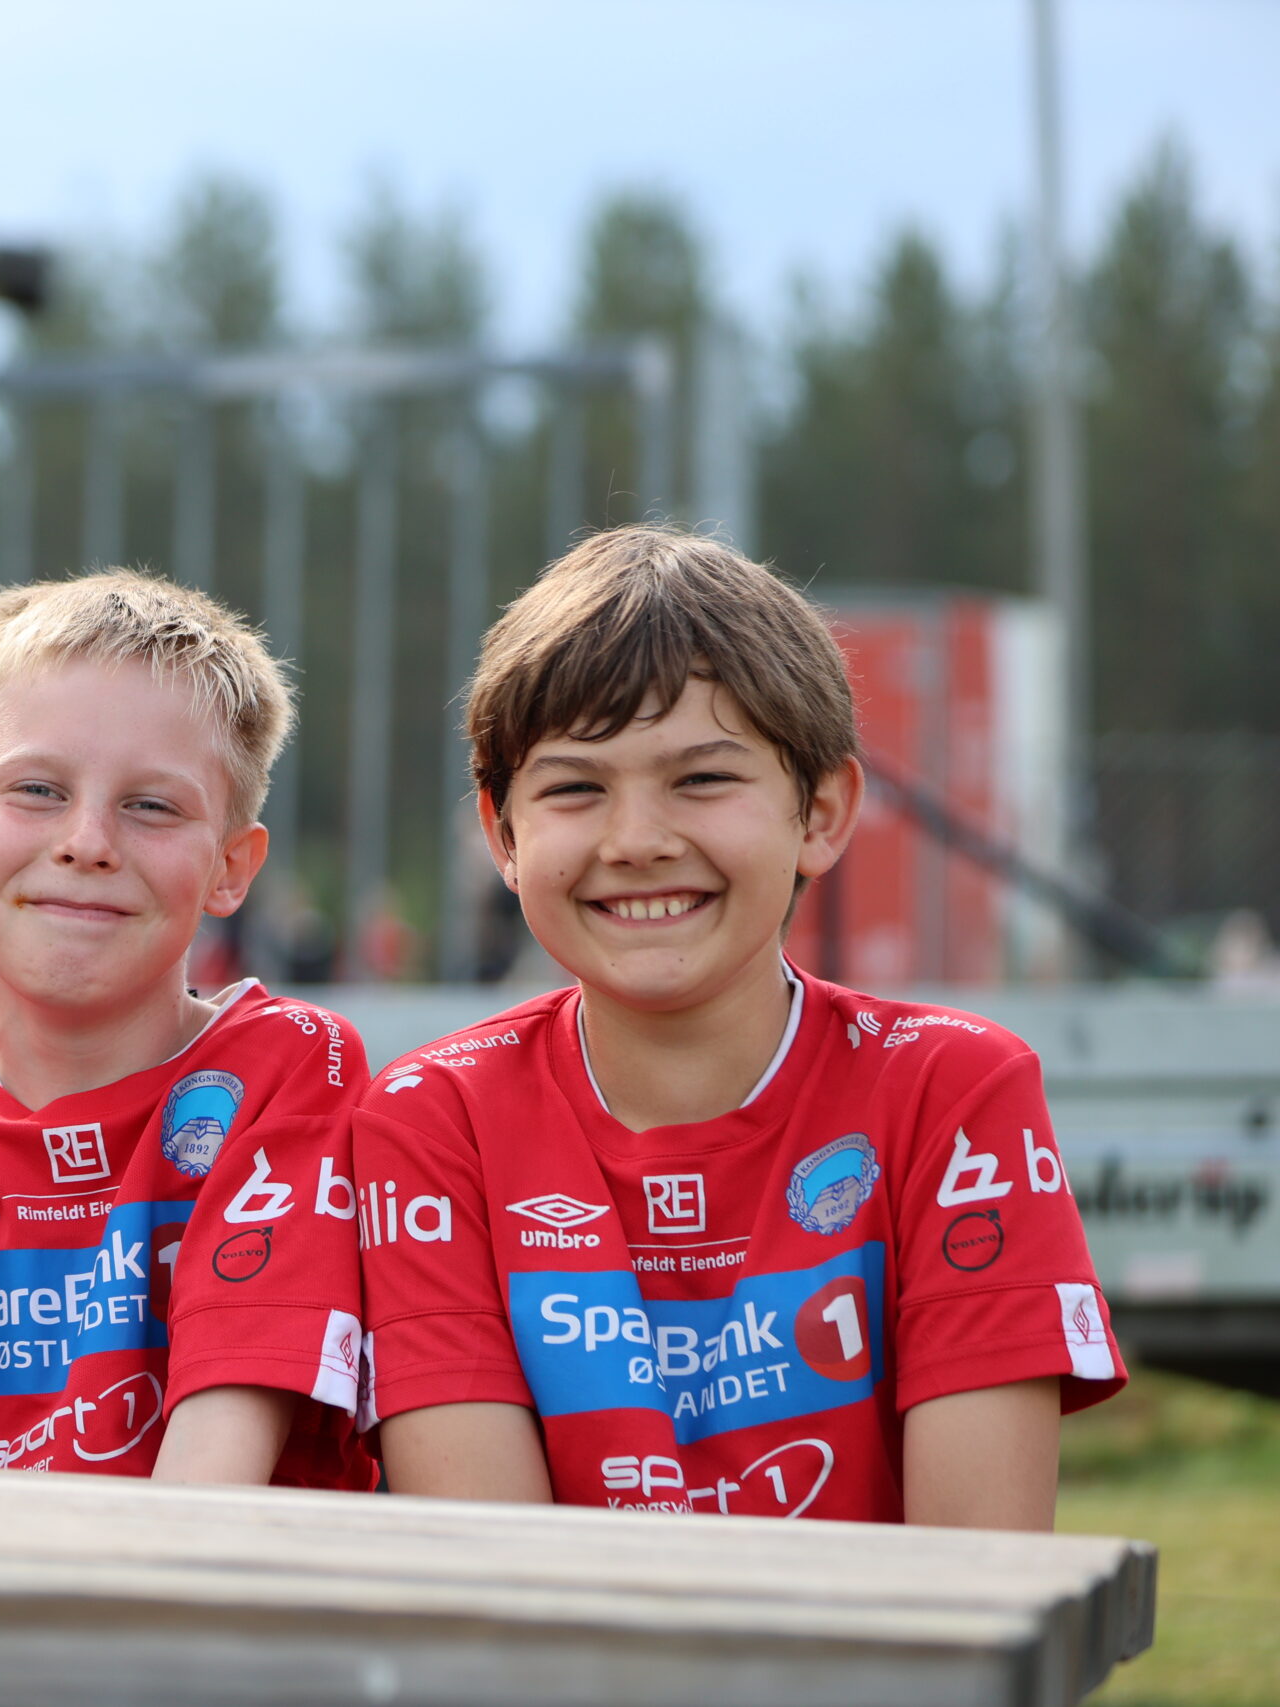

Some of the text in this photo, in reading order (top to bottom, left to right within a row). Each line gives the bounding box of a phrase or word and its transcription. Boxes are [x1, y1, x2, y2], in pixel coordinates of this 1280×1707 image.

[892, 1015, 987, 1035] Hafslund
[420, 1029, 521, 1060] Hafslund
[883, 1031, 920, 1049] Eco
[178, 1074, 239, 1093] KONGSVINGER
[184, 1143, 210, 1155] 1892
[17, 1205, 86, 1222] Rimfeldt
[520, 1229, 601, 1250] umbro
[950, 1234, 997, 1250] VOLVO
[220, 1249, 264, 1260] VOLVO
[822, 1293, 864, 1361] 1
[123, 1391, 136, 1429] 1
[765, 1465, 788, 1504] 1
